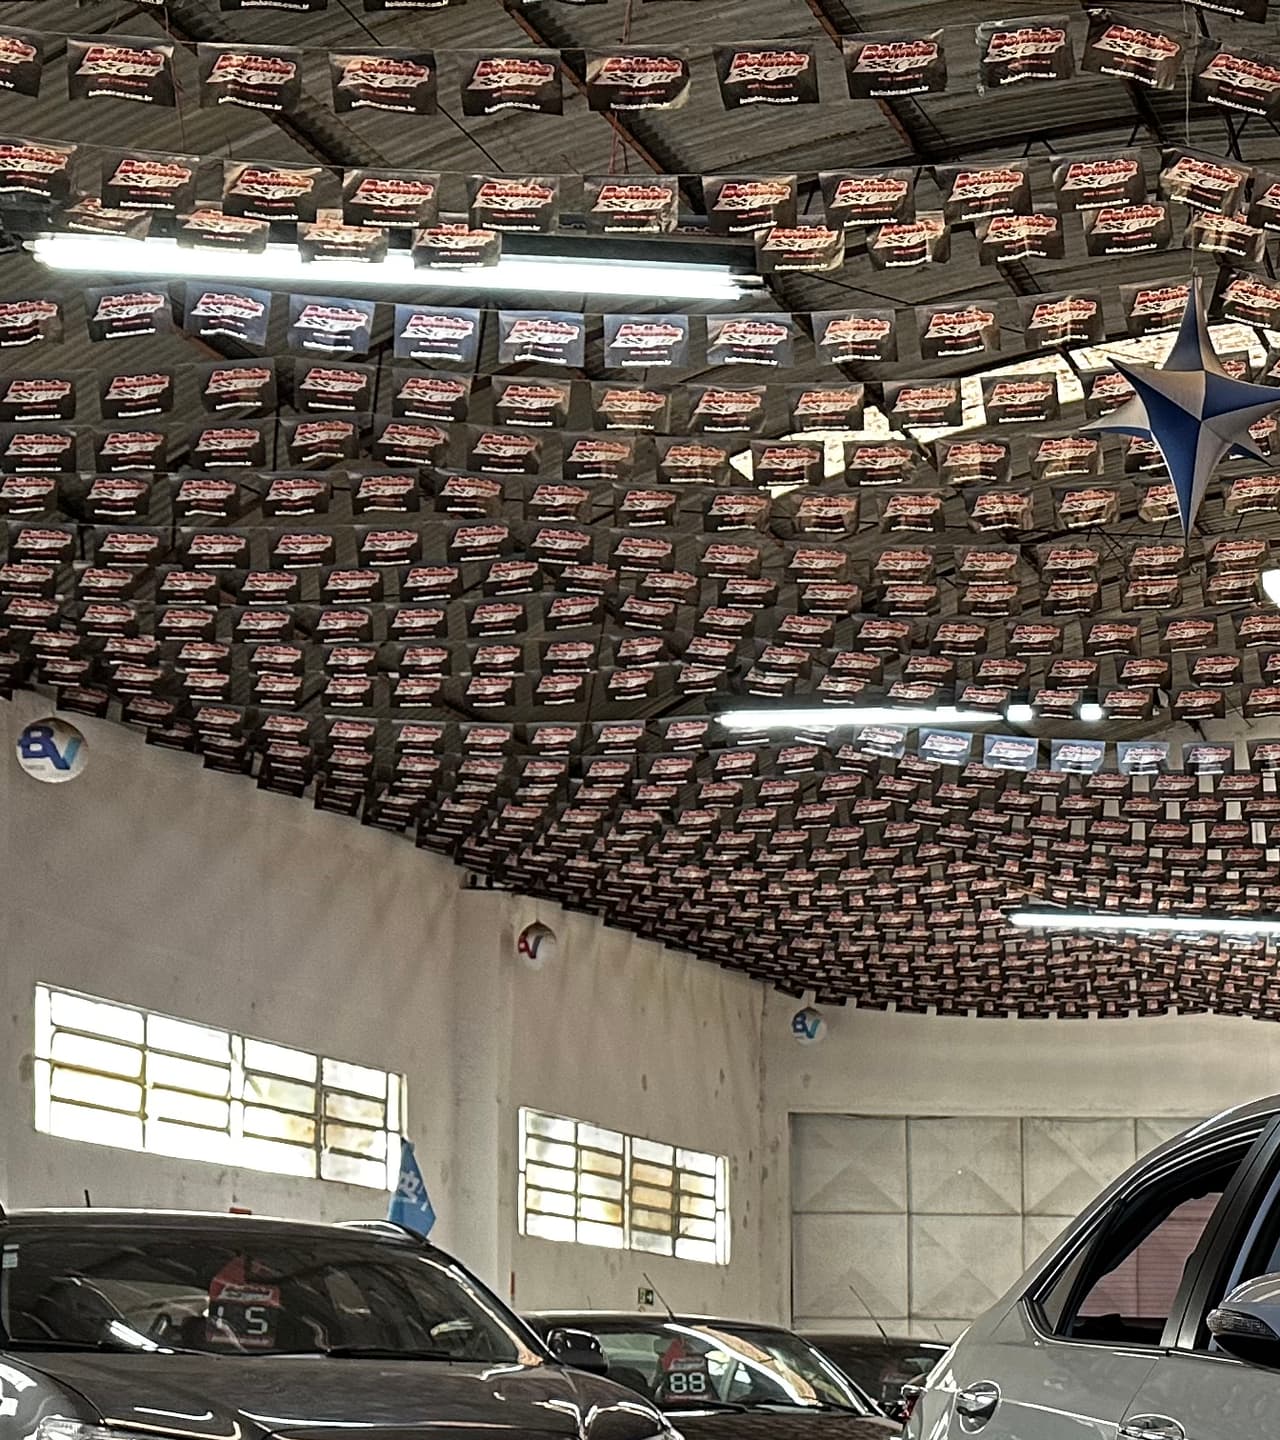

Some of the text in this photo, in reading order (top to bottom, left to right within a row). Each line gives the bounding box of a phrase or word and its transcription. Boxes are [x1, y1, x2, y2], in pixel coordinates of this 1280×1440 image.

[16, 726, 82, 771] BV
[215, 1305, 269, 1335] 15
[669, 1372, 706, 1393] 88
